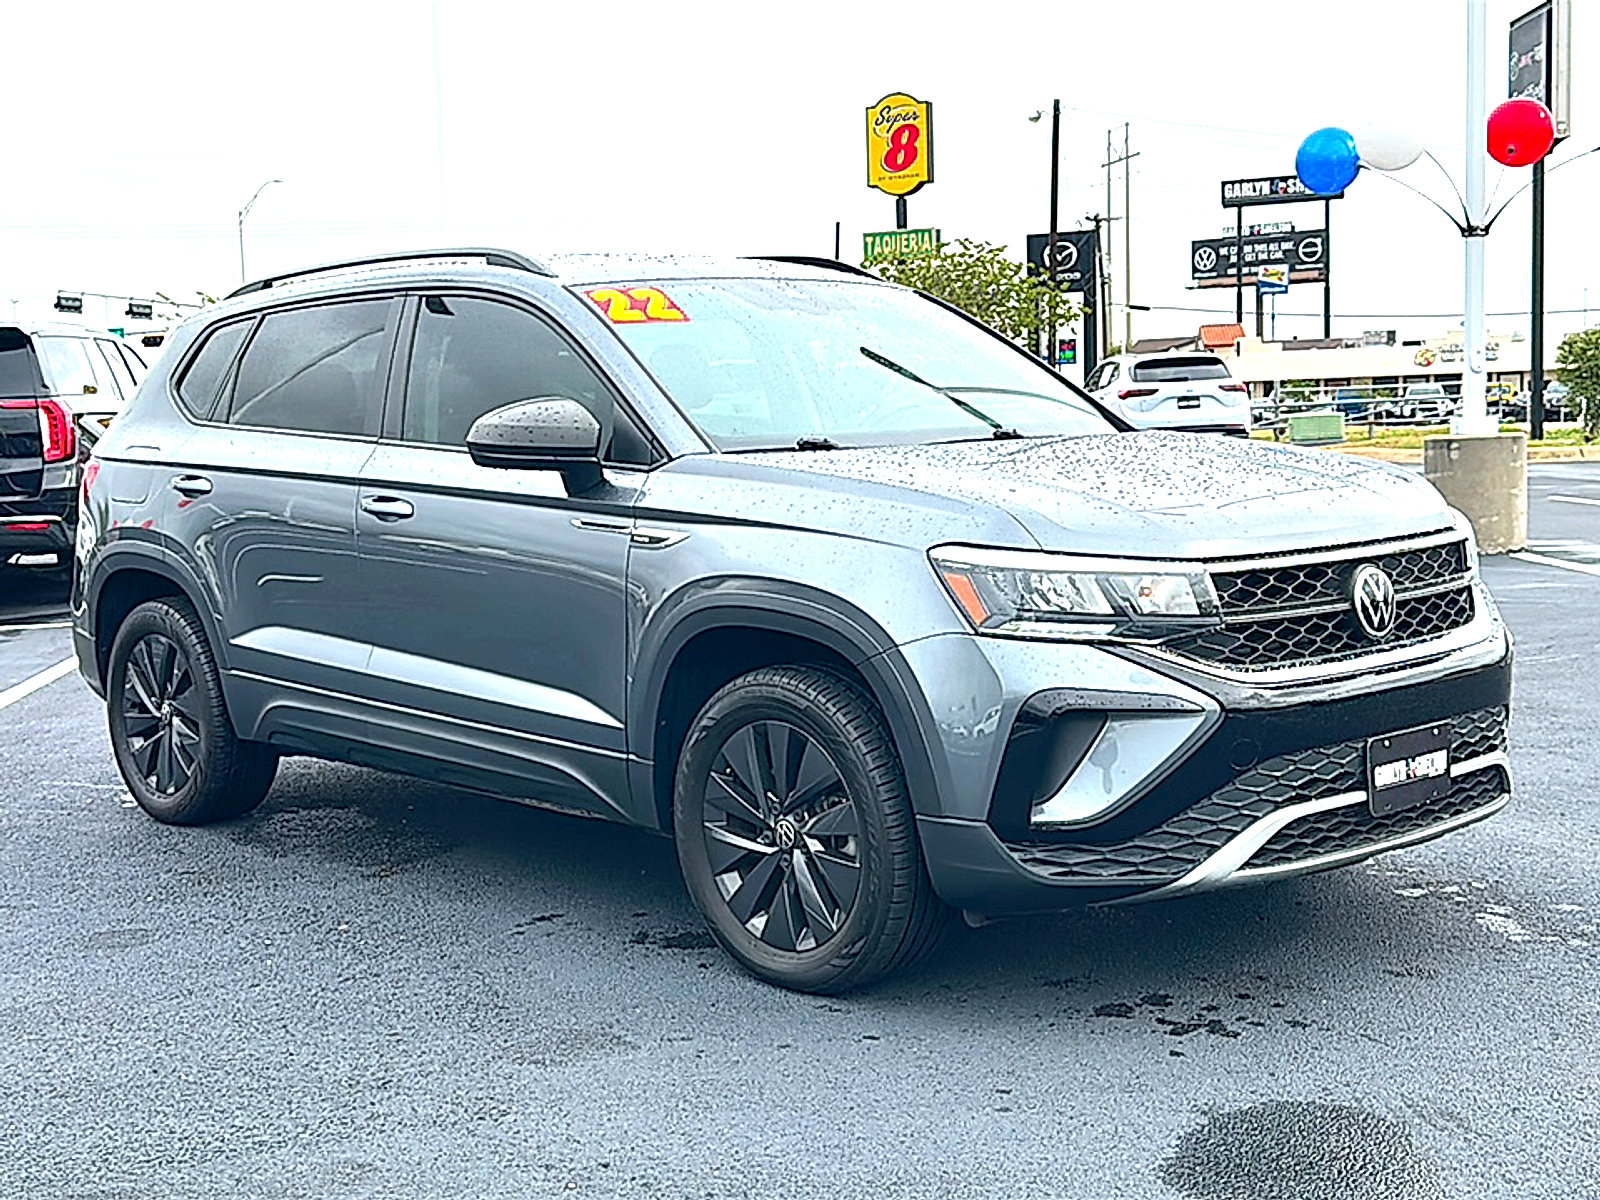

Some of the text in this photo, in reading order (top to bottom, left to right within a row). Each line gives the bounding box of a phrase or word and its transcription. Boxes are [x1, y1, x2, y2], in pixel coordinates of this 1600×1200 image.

[875, 105, 920, 133] Super
[883, 123, 920, 172] 8
[865, 232, 932, 257] TAQUERIA
[587, 287, 685, 322] 22
